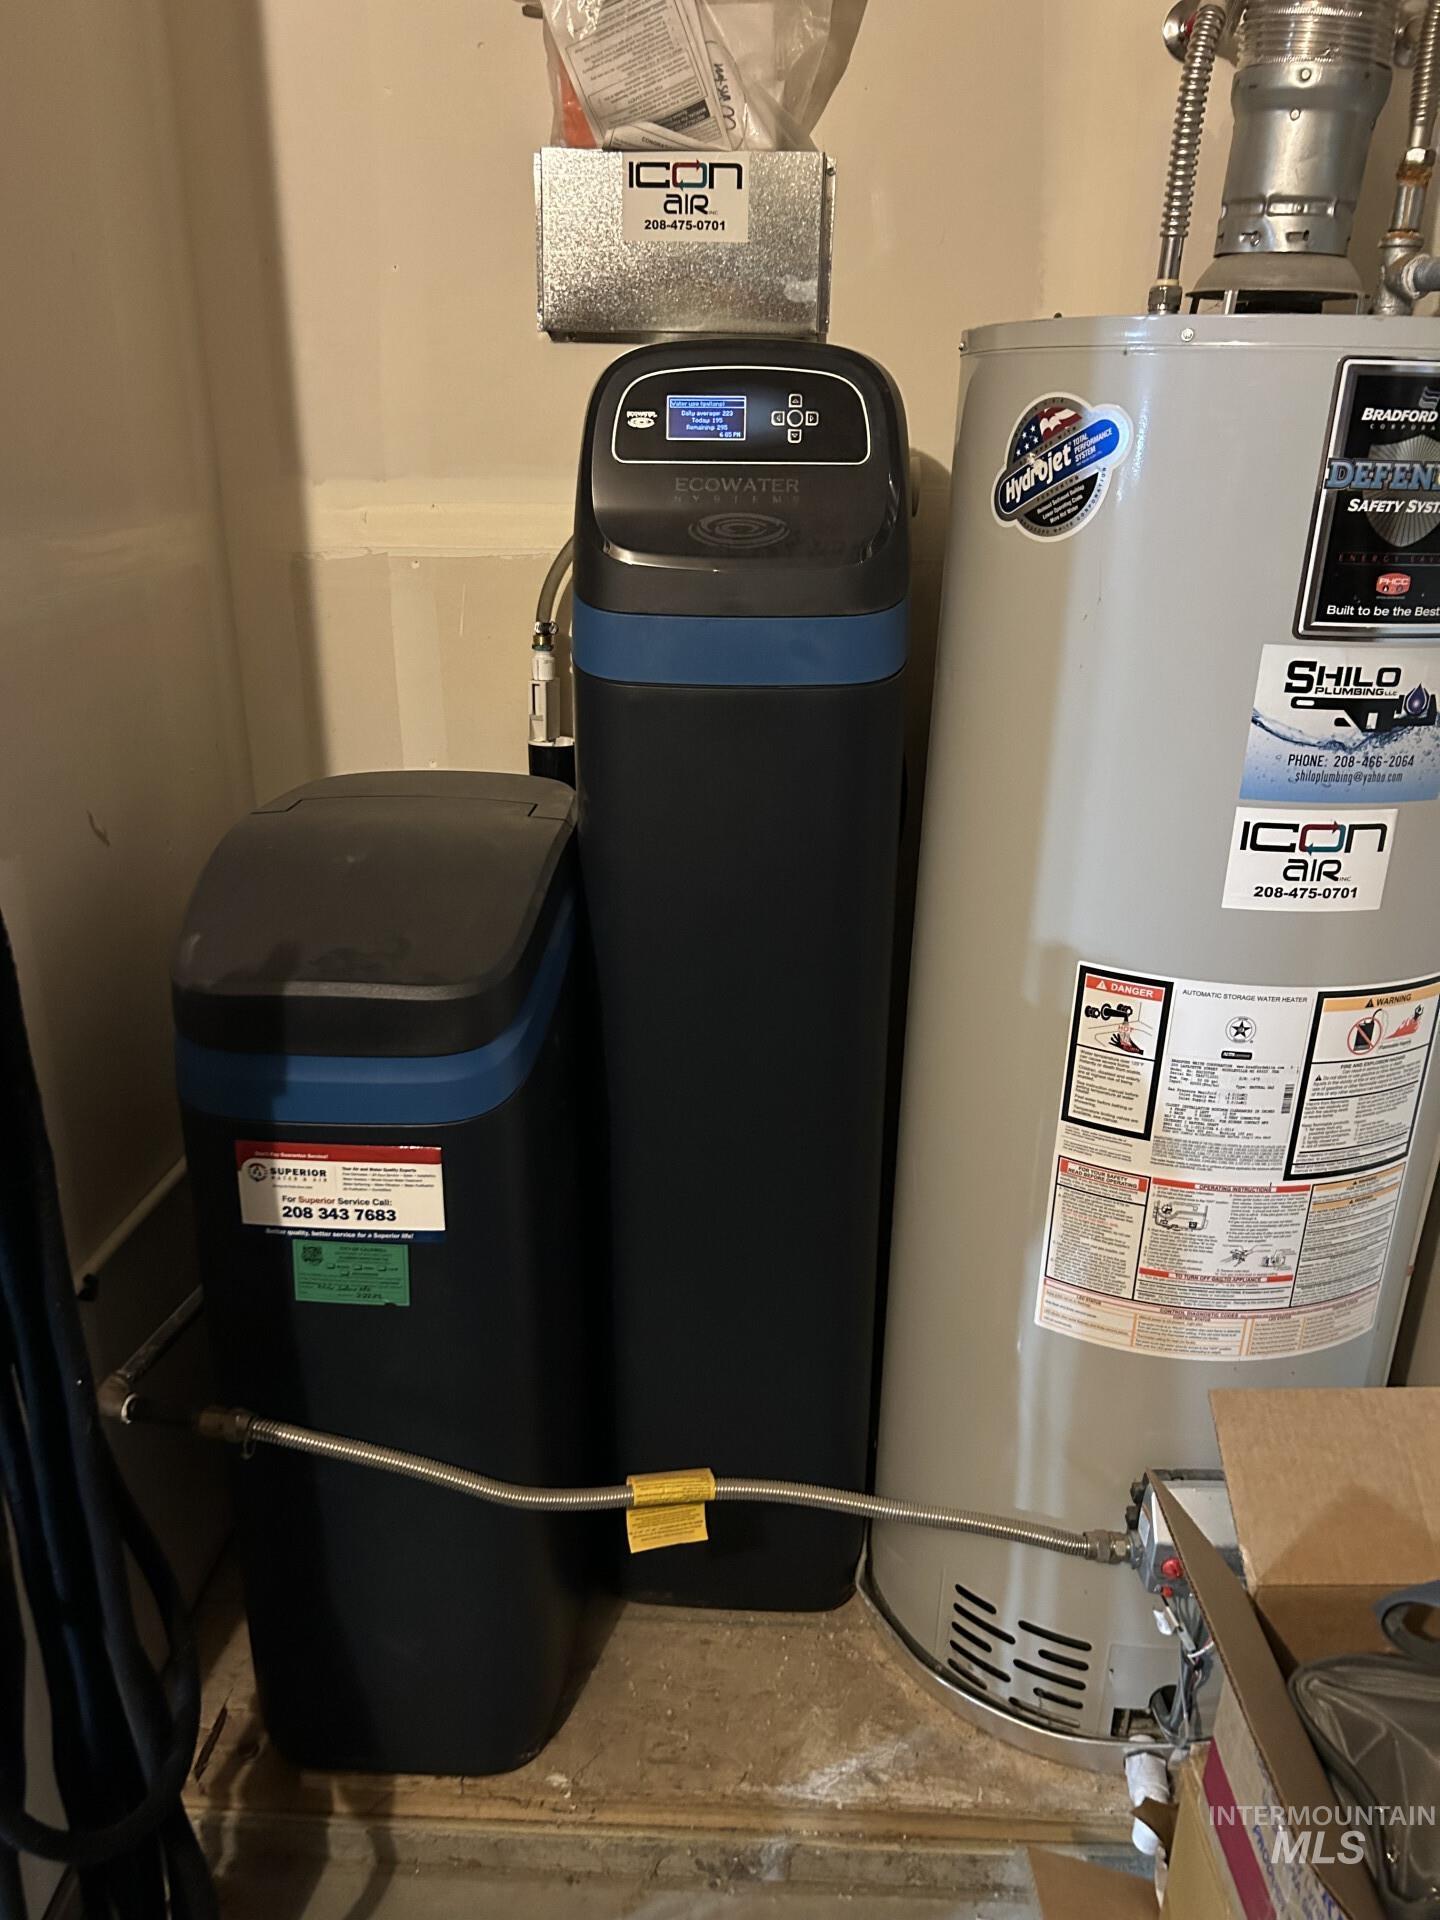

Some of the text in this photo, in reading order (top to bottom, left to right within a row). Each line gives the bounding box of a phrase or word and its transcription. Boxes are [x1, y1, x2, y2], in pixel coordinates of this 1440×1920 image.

[644, 219, 726, 231] 208-475-0701
[1361, 407, 1439, 422] BRADFORD
[1073, 432, 1089, 446] TOTAL
[1074, 427, 1113, 455] PERFORMANCE
[1075, 446, 1096, 462] SYSTEM
[1006, 444, 1072, 504] Hydrojet
[675, 477, 800, 493] ECOWATER
[1347, 499, 1405, 513] SAFETY
[1379, 577, 1410, 586] PHCC
[1326, 605, 1355, 616] Built
[1358, 605, 1371, 616] to
[1374, 605, 1390, 617] be
[1393, 606, 1412, 617] the
[1284, 660, 1402, 694] SHILO
[1314, 687, 1385, 696] PLUMBING
[1287, 753, 1415, 768] PHONE: 208-466-2064
[1295, 770, 1404, 786] shiloplumbing@yahoo.com
[1253, 886, 1358, 899] 208-475-0701
[1110, 982, 1154, 998] DANGER
[1182, 988, 1222, 999] AUTOMATIC
[1223, 993, 1255, 1002] STORAGE
[1257, 995, 1281, 1003] WATER
[1376, 993, 1412, 1007] WARNING
[270, 1167, 327, 1177] SUPERIOR
[282, 1195, 393, 1206] For Superior Service Call:
[282, 1206, 397, 1221] 208 343 7683
